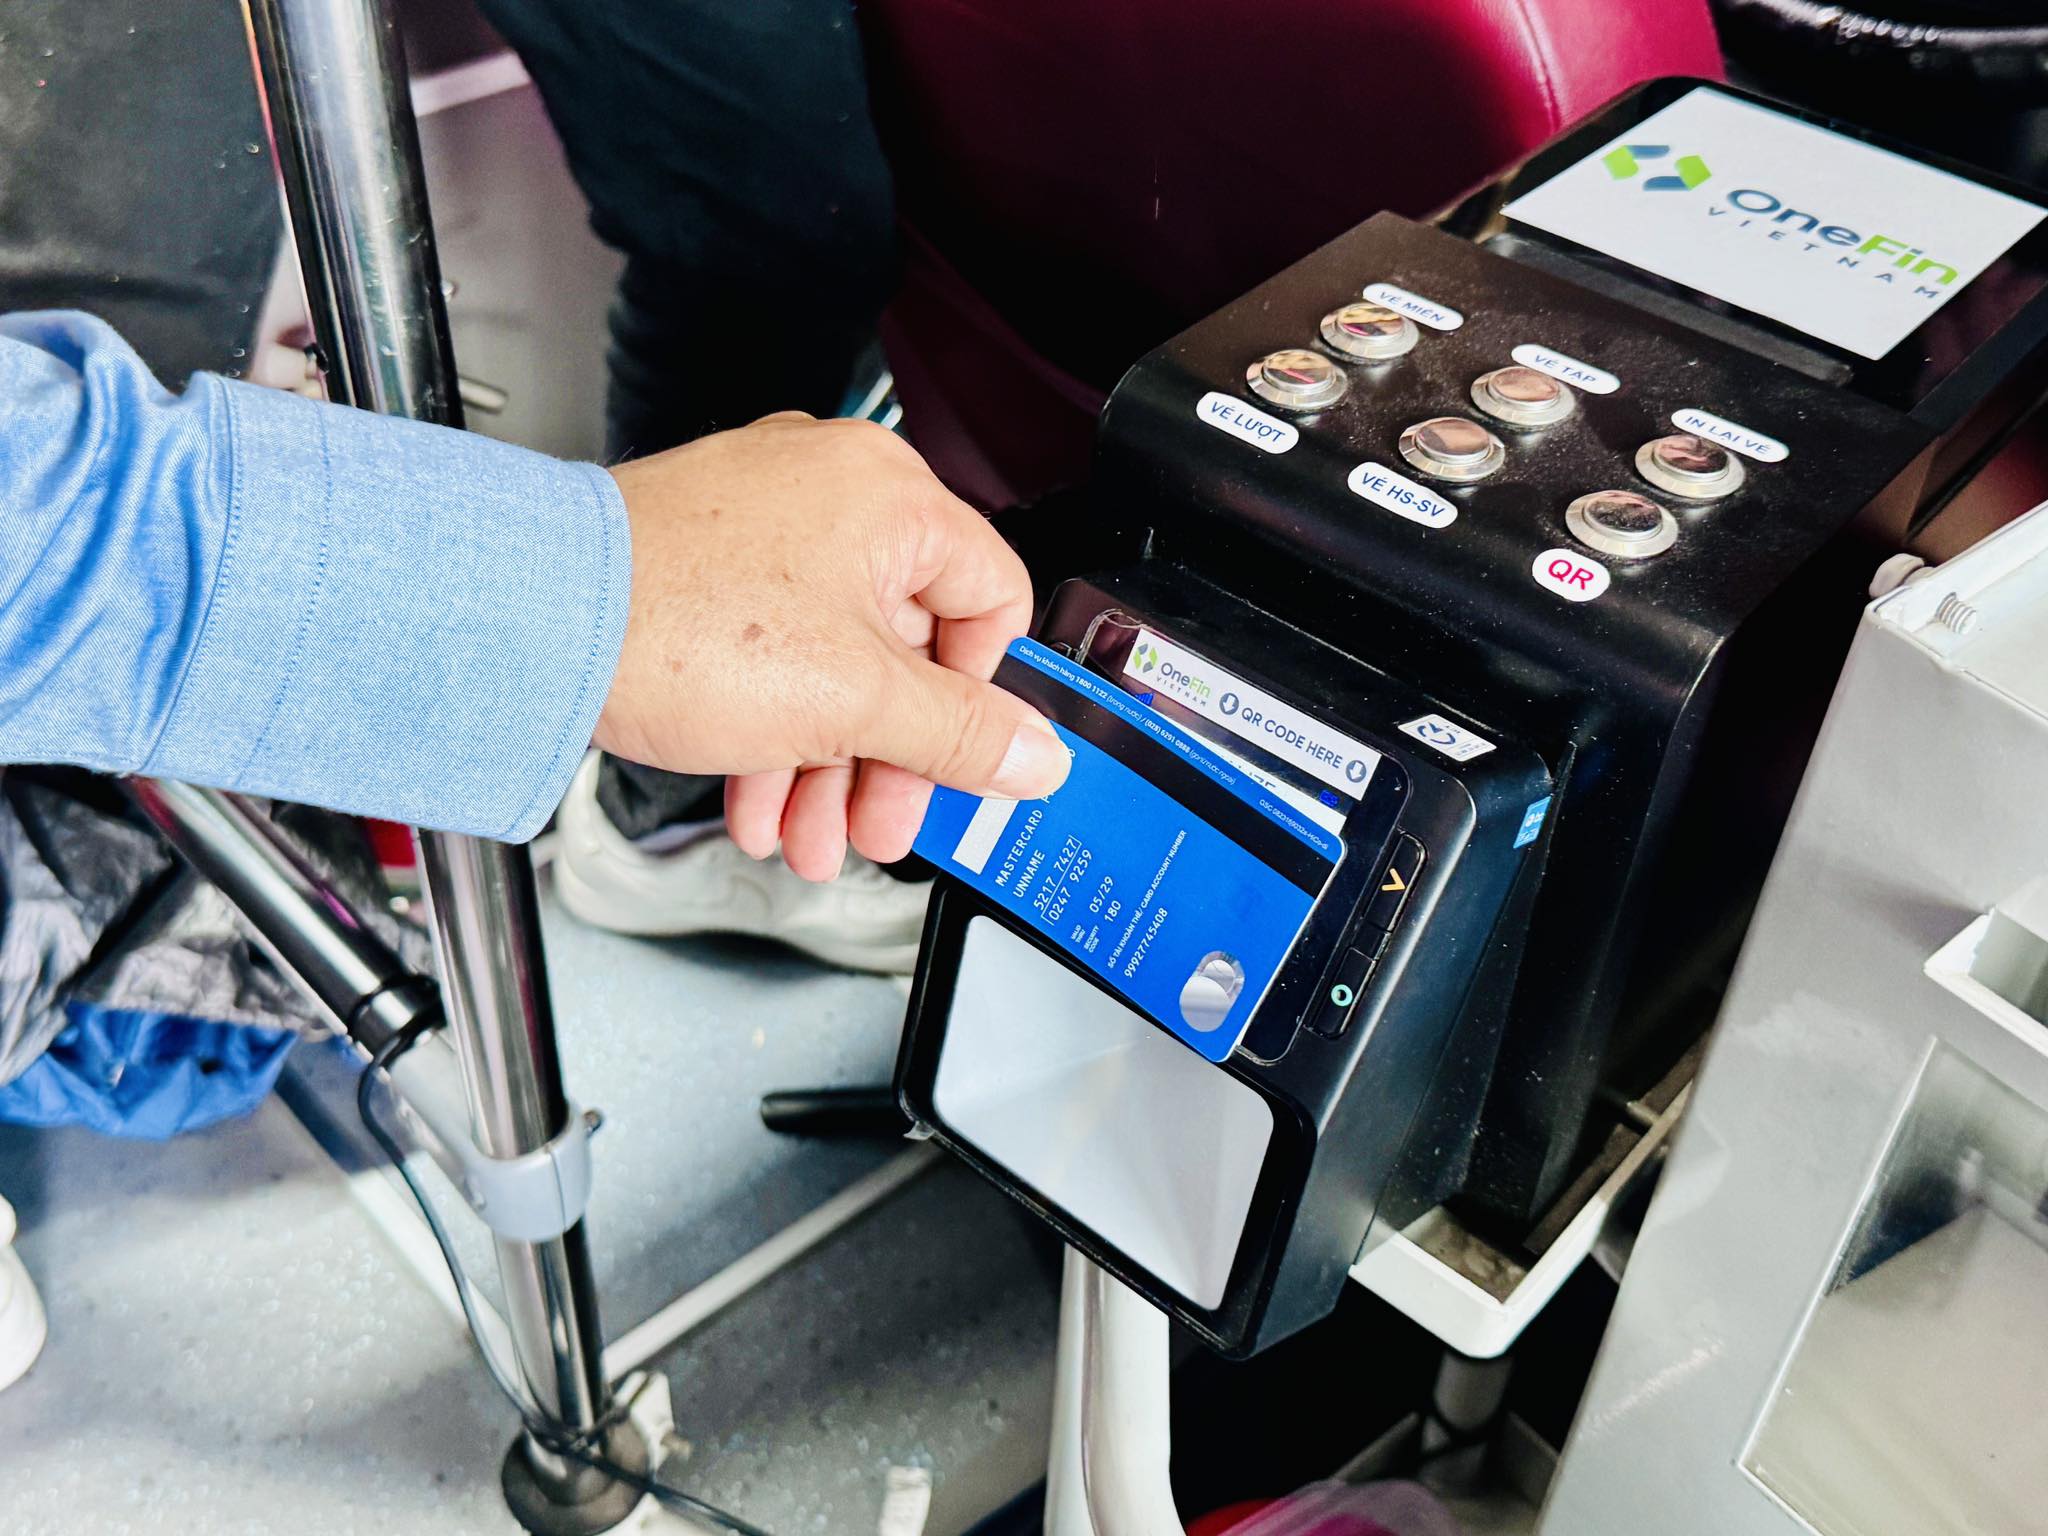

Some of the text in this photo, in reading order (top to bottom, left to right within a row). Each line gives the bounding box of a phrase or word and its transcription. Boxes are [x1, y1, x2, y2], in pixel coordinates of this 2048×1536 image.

[1708, 206, 1939, 299] VIETNAM
[1726, 189, 1960, 285] OneFin
[1211, 400, 1285, 441] VÉ LƯỢT
[1684, 416, 1705, 427] IN
[1362, 472, 1445, 516] VÉ HS-SV
[1548, 559, 1594, 590] QR
[1075, 676, 1091, 689] 1800
[1091, 685, 1107, 698] 1122
[1157, 676, 1206, 706] VIETNAM
[1161, 663, 1211, 695] OneFin
[1241, 709, 1343, 769] QR CODE HERE
[995, 807, 1043, 887] MASTERCARD
[1140, 887, 1154, 908] CARD
[1150, 856, 1172, 890] ACCOUNT
[1168, 829, 1187, 857] NUMBER
[1012, 849, 1045, 898] UNNAME
[1033, 837, 1077, 910] 5217 7427
[1048, 848, 1092, 921] 0247 9259
[1087, 874, 1115, 913] 05/29
[1103, 898, 1121, 922] 180
[1083, 924, 1099, 950] SECURITY
[1122, 906, 1168, 978] 99927745408
